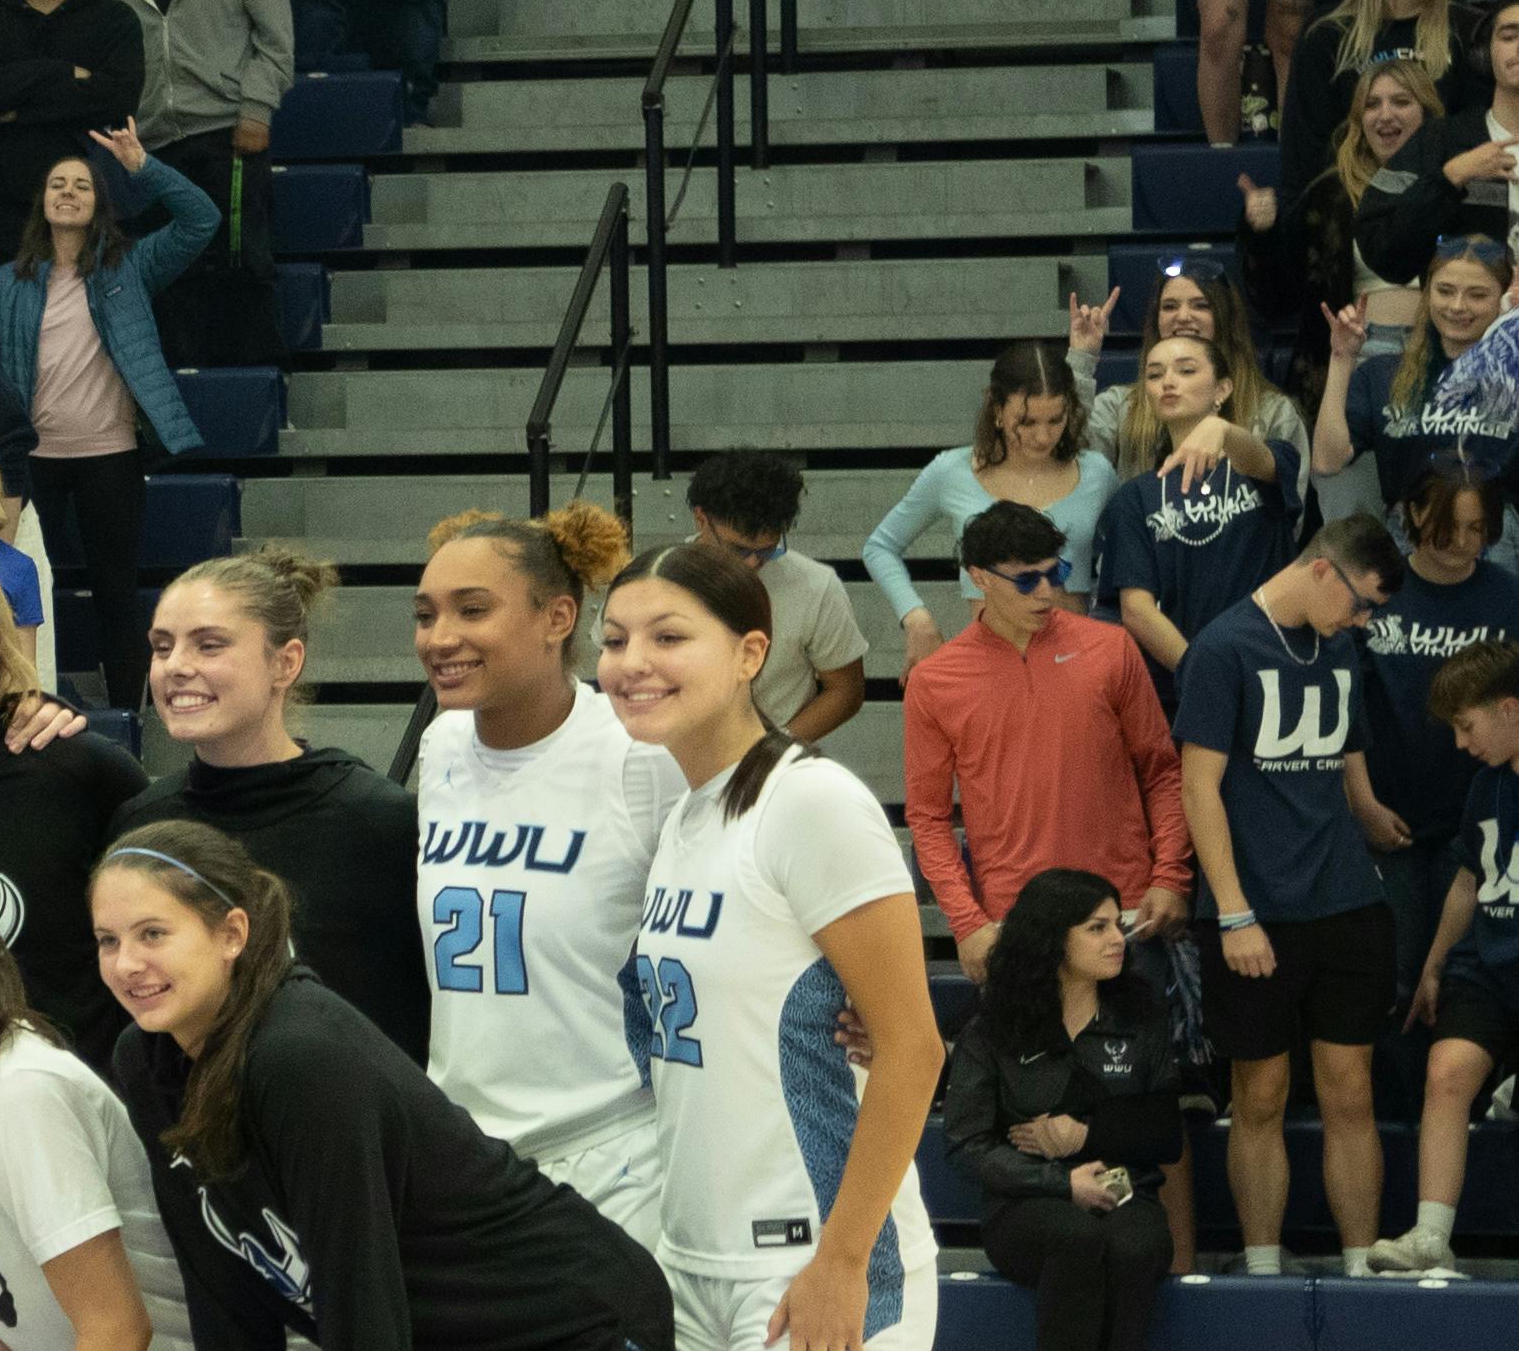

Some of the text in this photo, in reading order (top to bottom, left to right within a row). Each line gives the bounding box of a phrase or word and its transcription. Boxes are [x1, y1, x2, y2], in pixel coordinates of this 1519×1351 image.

[1253, 668, 1352, 759] W
[421, 821, 586, 875] WWU
[432, 885, 529, 995] 21
[1103, 1063, 1133, 1074] WWU
